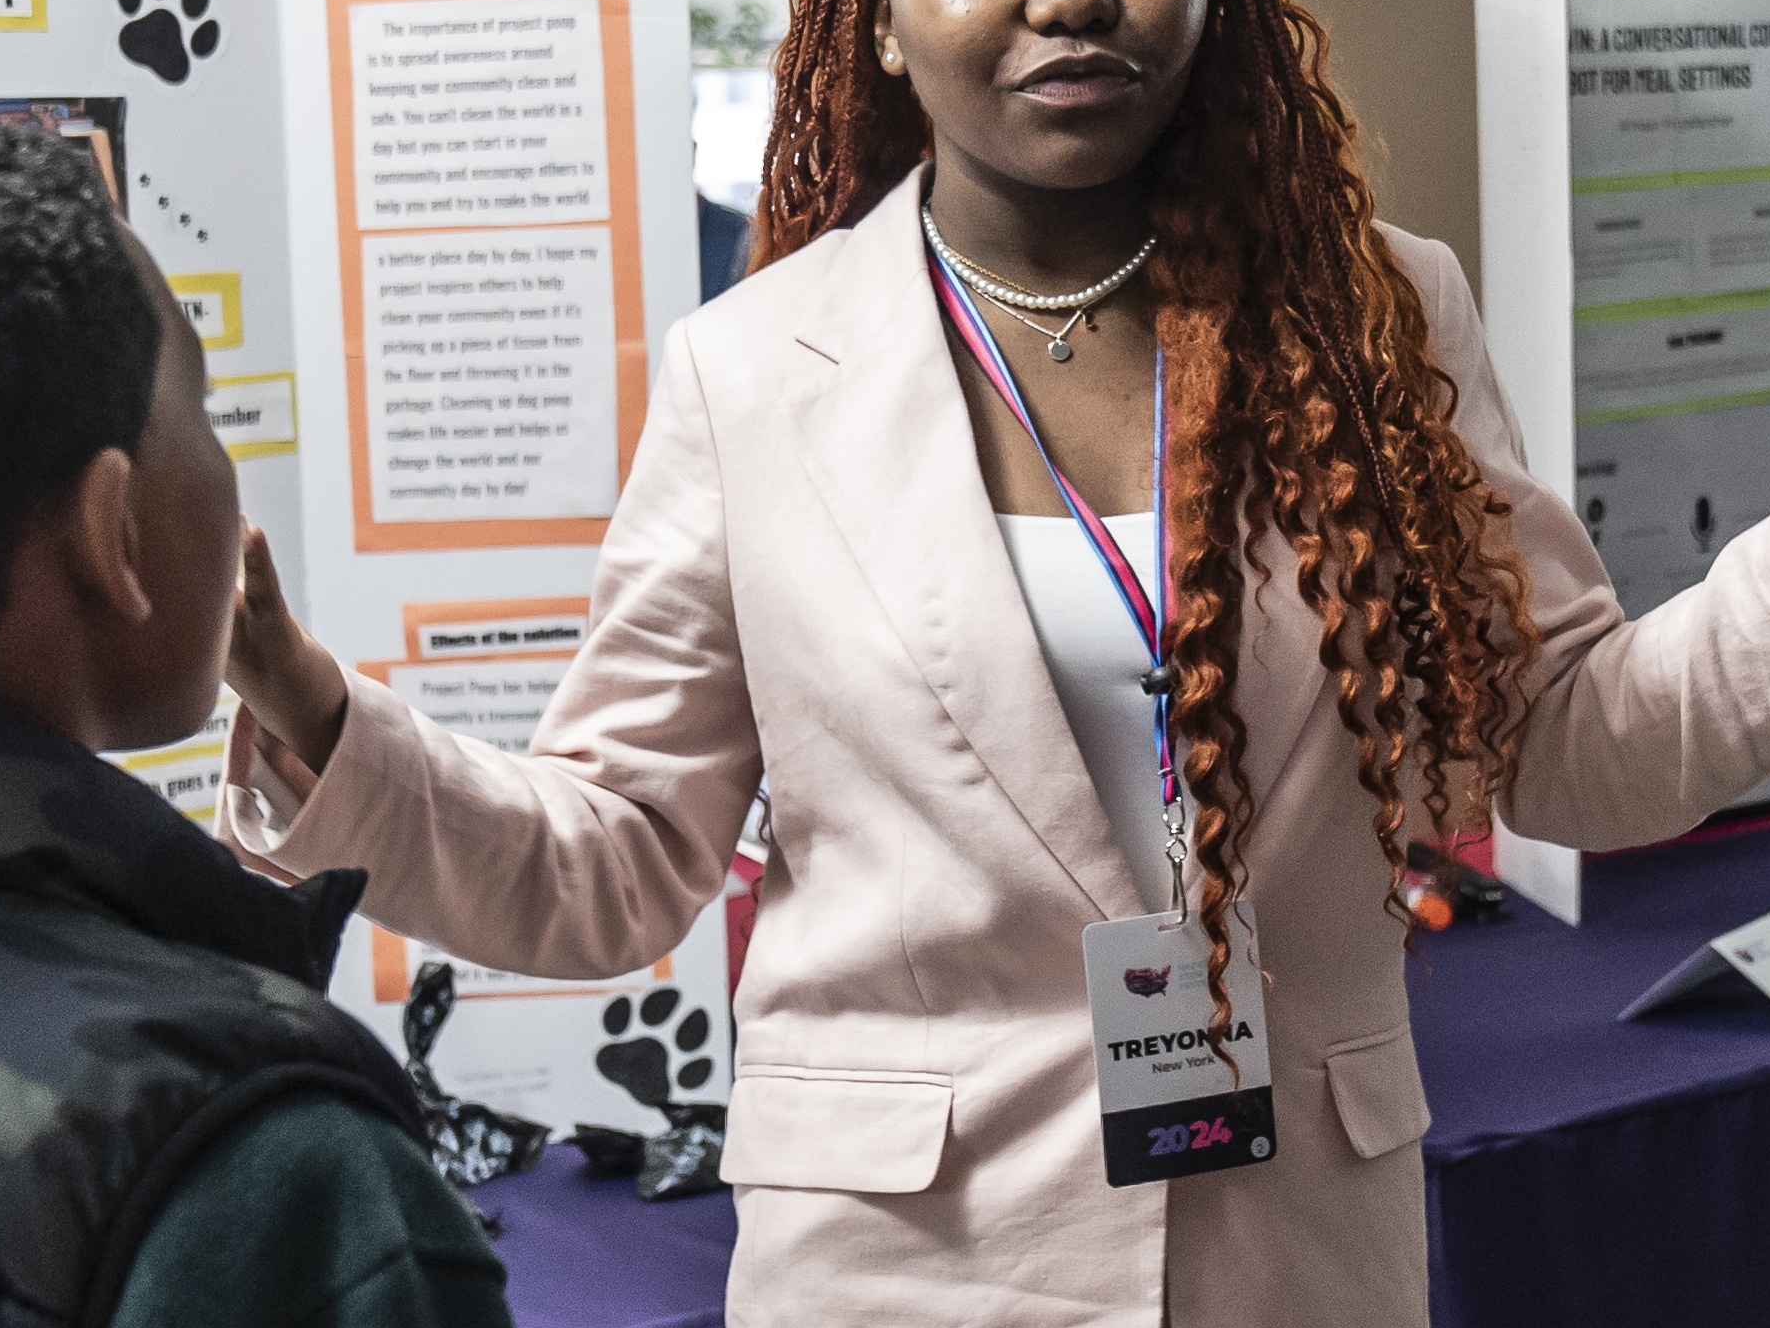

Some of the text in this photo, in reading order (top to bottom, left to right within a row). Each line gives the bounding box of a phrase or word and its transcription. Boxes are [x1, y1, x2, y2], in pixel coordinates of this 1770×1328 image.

[1600, 28, 1610, 52] A
[1613, 23, 1746, 52] CONVERSATIONAL
[554, 74, 576, 88] and
[1601, 66, 1632, 94] FOR
[1634, 66, 1674, 92] MEAL
[1678, 64, 1752, 91] SETTINGS
[497, 106, 517, 119] the
[446, 168, 467, 182] and
[431, 198, 453, 211] and
[530, 193, 551, 207] the
[384, 369, 402, 383] the
[440, 368, 462, 381] and
[551, 363, 571, 377] the
[493, 424, 516, 437] and
[435, 454, 454, 468] the
[497, 453, 519, 466] and
[497, 631, 519, 643] the
[167, 776, 203, 799] goes
[1152, 1054, 1216, 1074] New York
[1147, 1116, 1233, 1157] 2024
